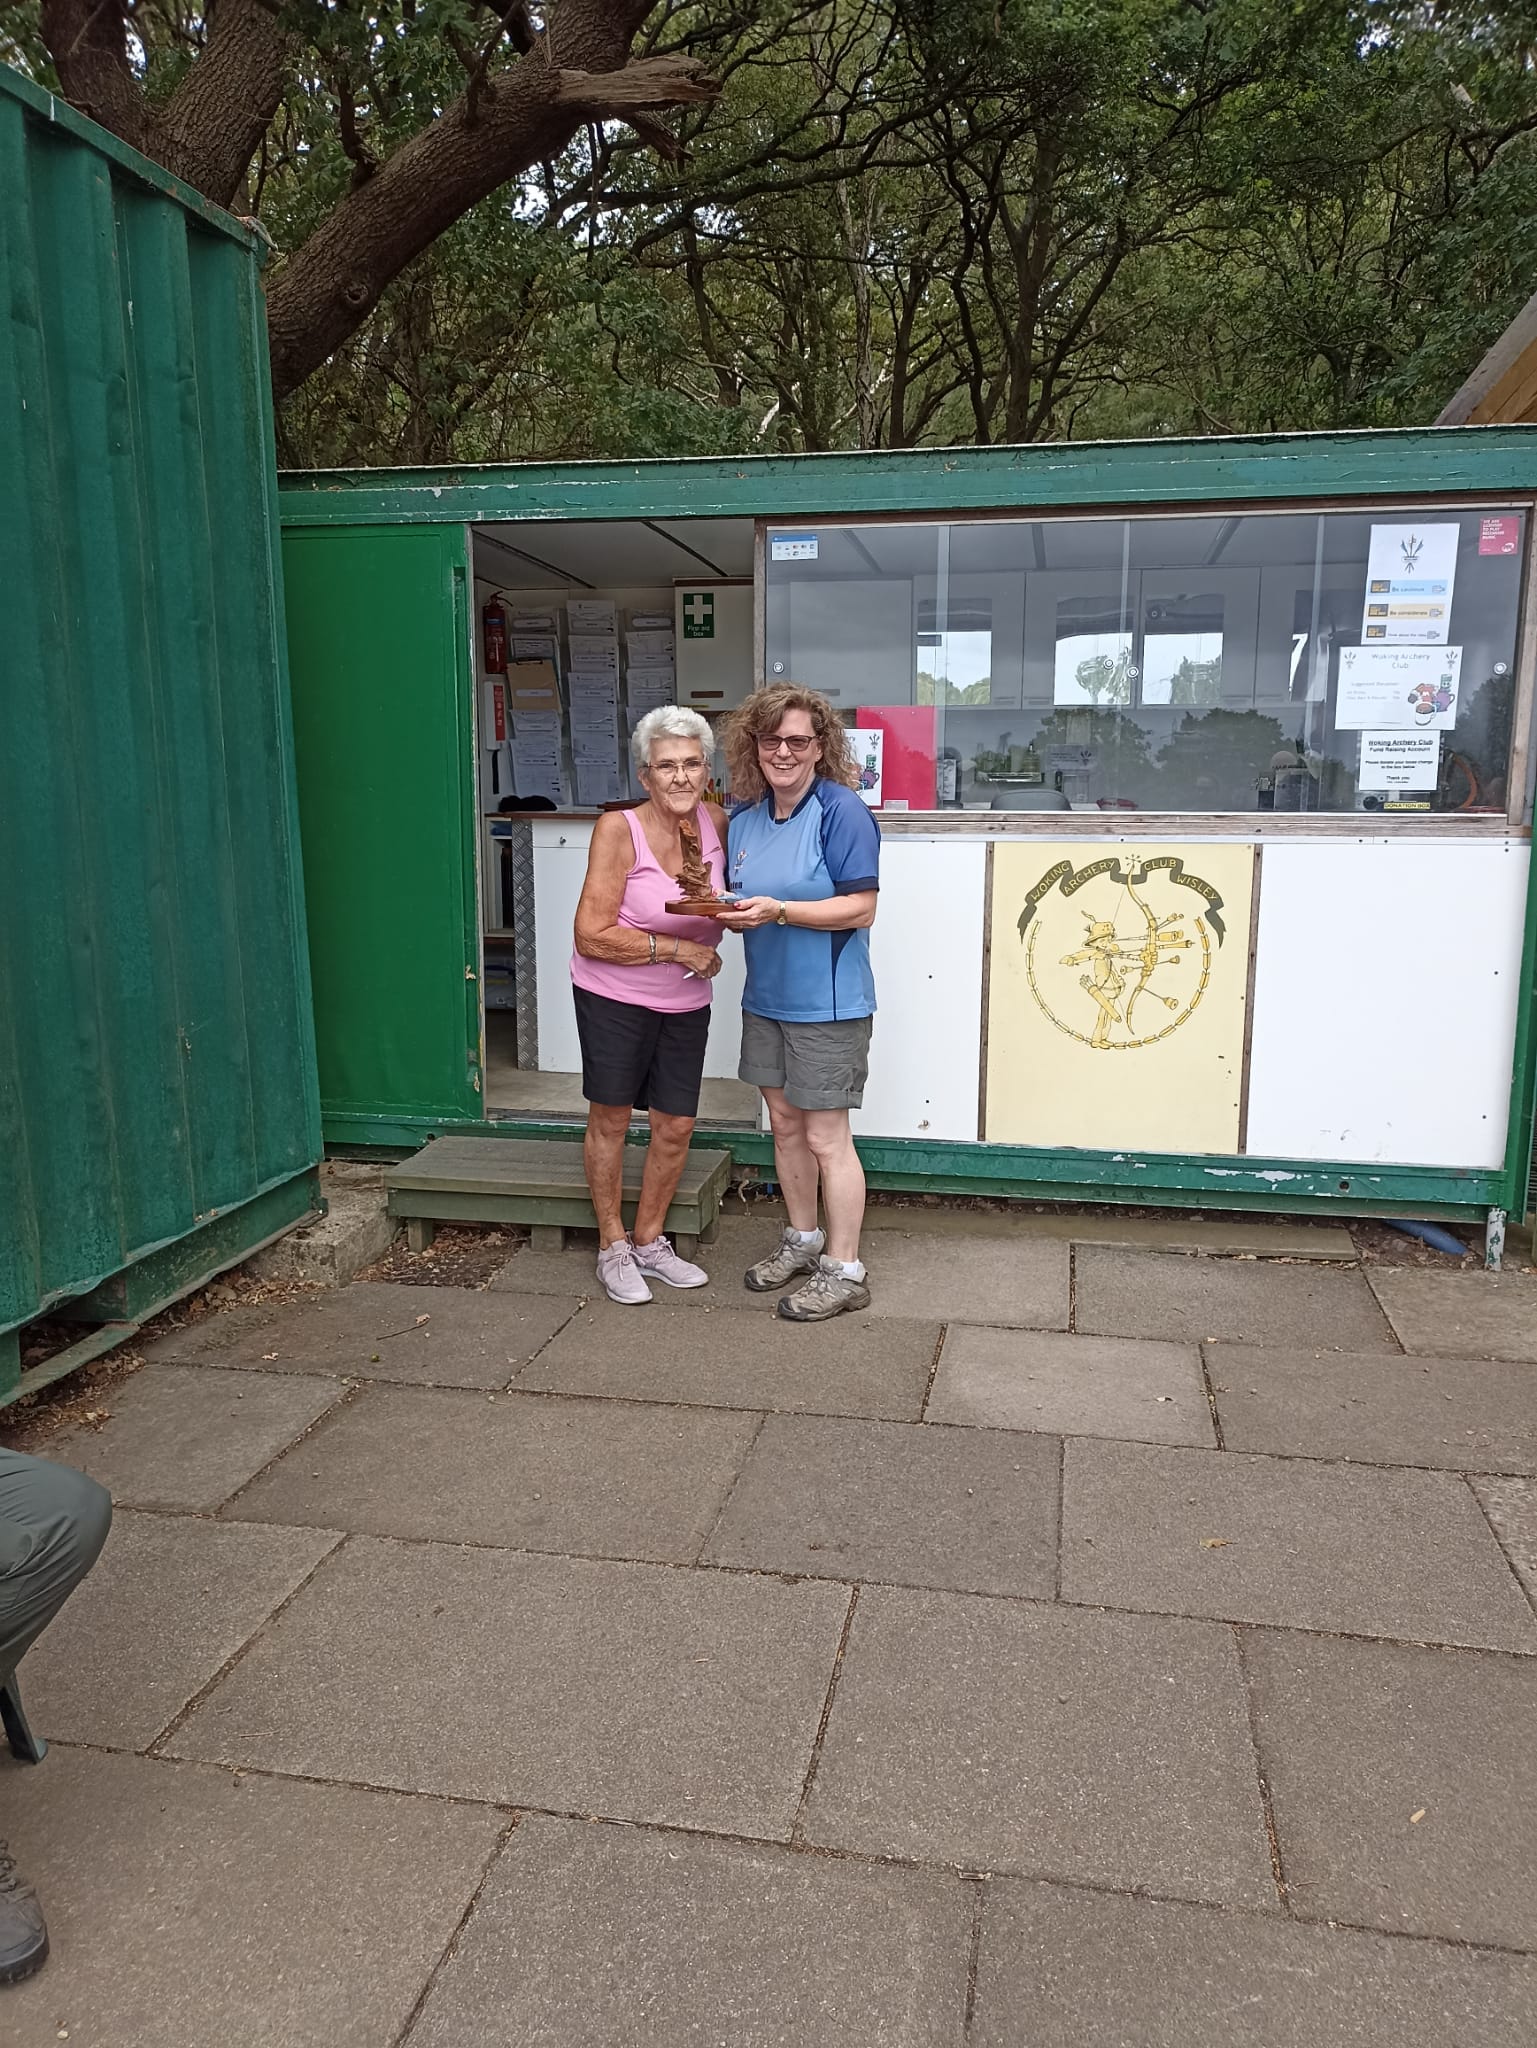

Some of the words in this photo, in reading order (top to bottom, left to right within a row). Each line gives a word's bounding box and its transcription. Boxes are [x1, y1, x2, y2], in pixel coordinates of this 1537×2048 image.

[1400, 653, 1431, 661] Archery
[1031, 861, 1071, 901] WOKING
[1063, 859, 1116, 895] ARCHERY
[1143, 859, 1178, 871] CLUB
[1177, 874, 1218, 901] WISLEY
